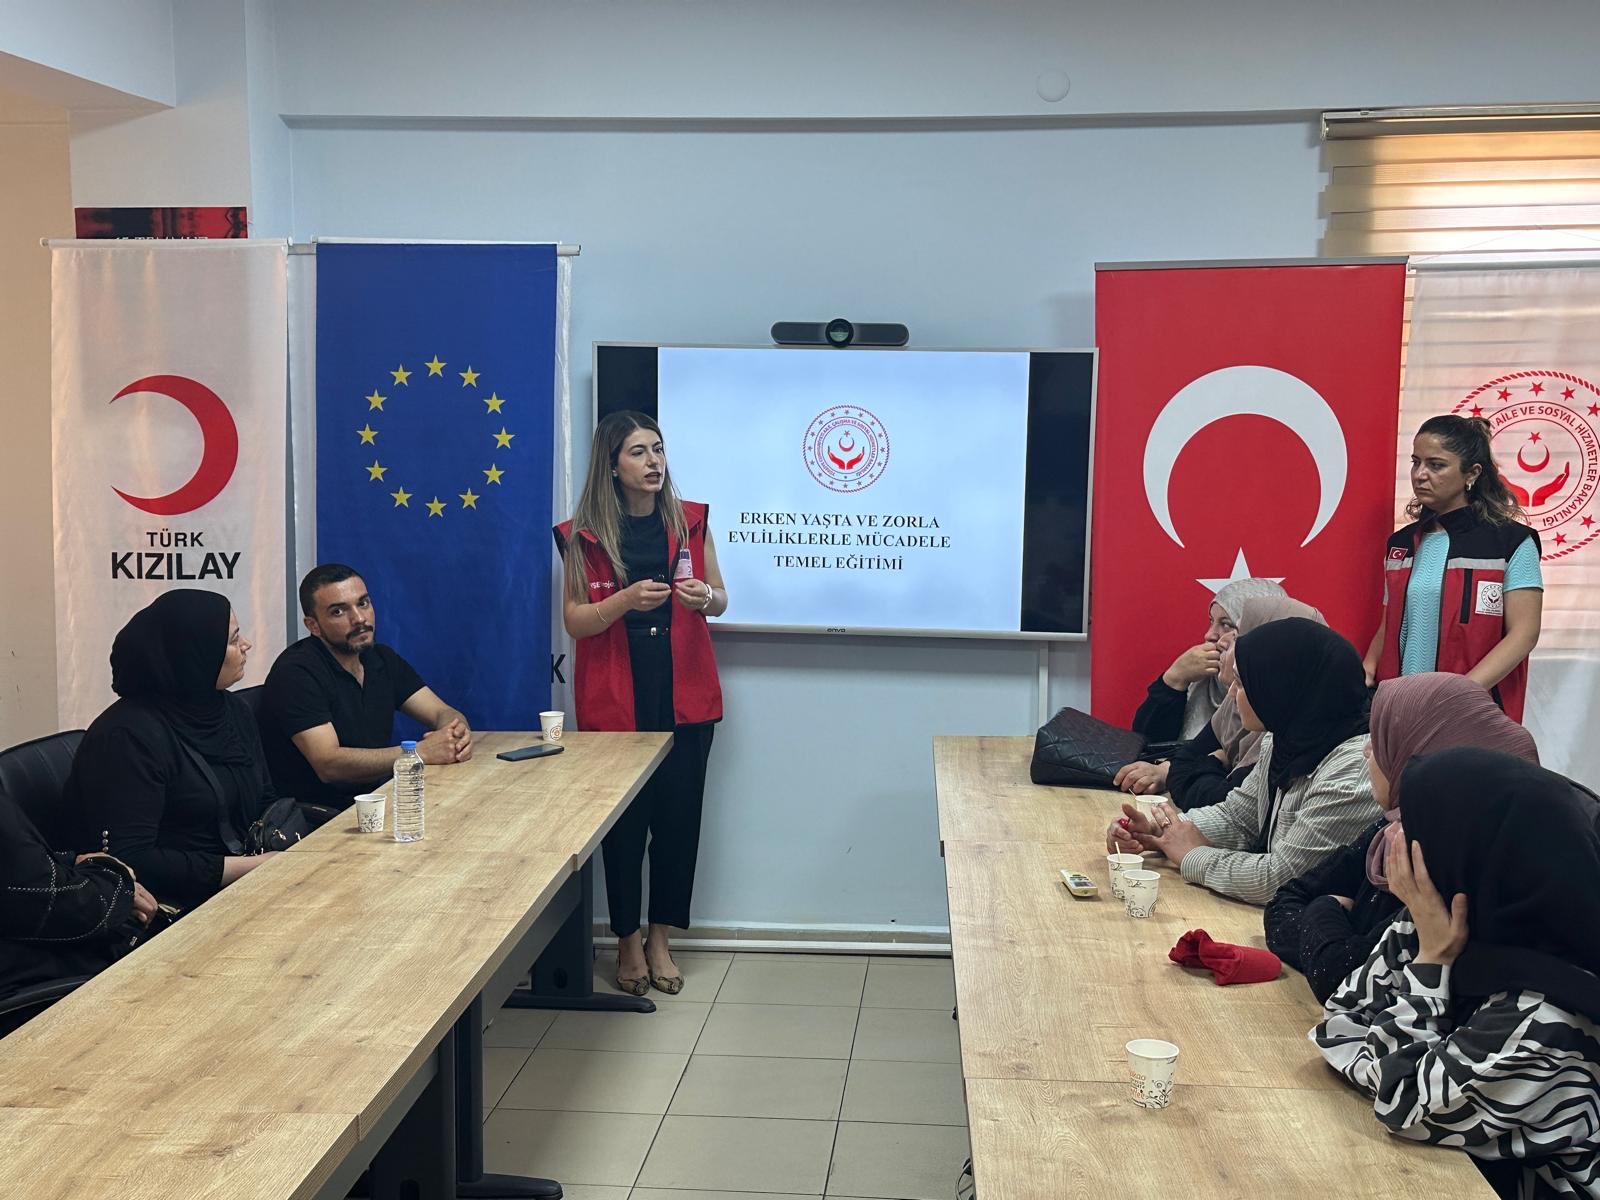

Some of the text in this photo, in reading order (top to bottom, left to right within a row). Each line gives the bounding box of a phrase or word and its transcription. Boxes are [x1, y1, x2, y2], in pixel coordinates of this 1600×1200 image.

[1495, 406, 1598, 526] AİLE VE SOSYAL HİZMETLER BAKANLIĞI
[740, 512, 940, 528] ERKEN YAŞTA VE ZORLA
[146, 528, 204, 548] TÜRK
[728, 529, 951, 548] EVLİLİKLERLE MÜCADELE
[112, 552, 241, 580] KIZILAY
[774, 554, 904, 570] TEMEL EĞİTİMİ
